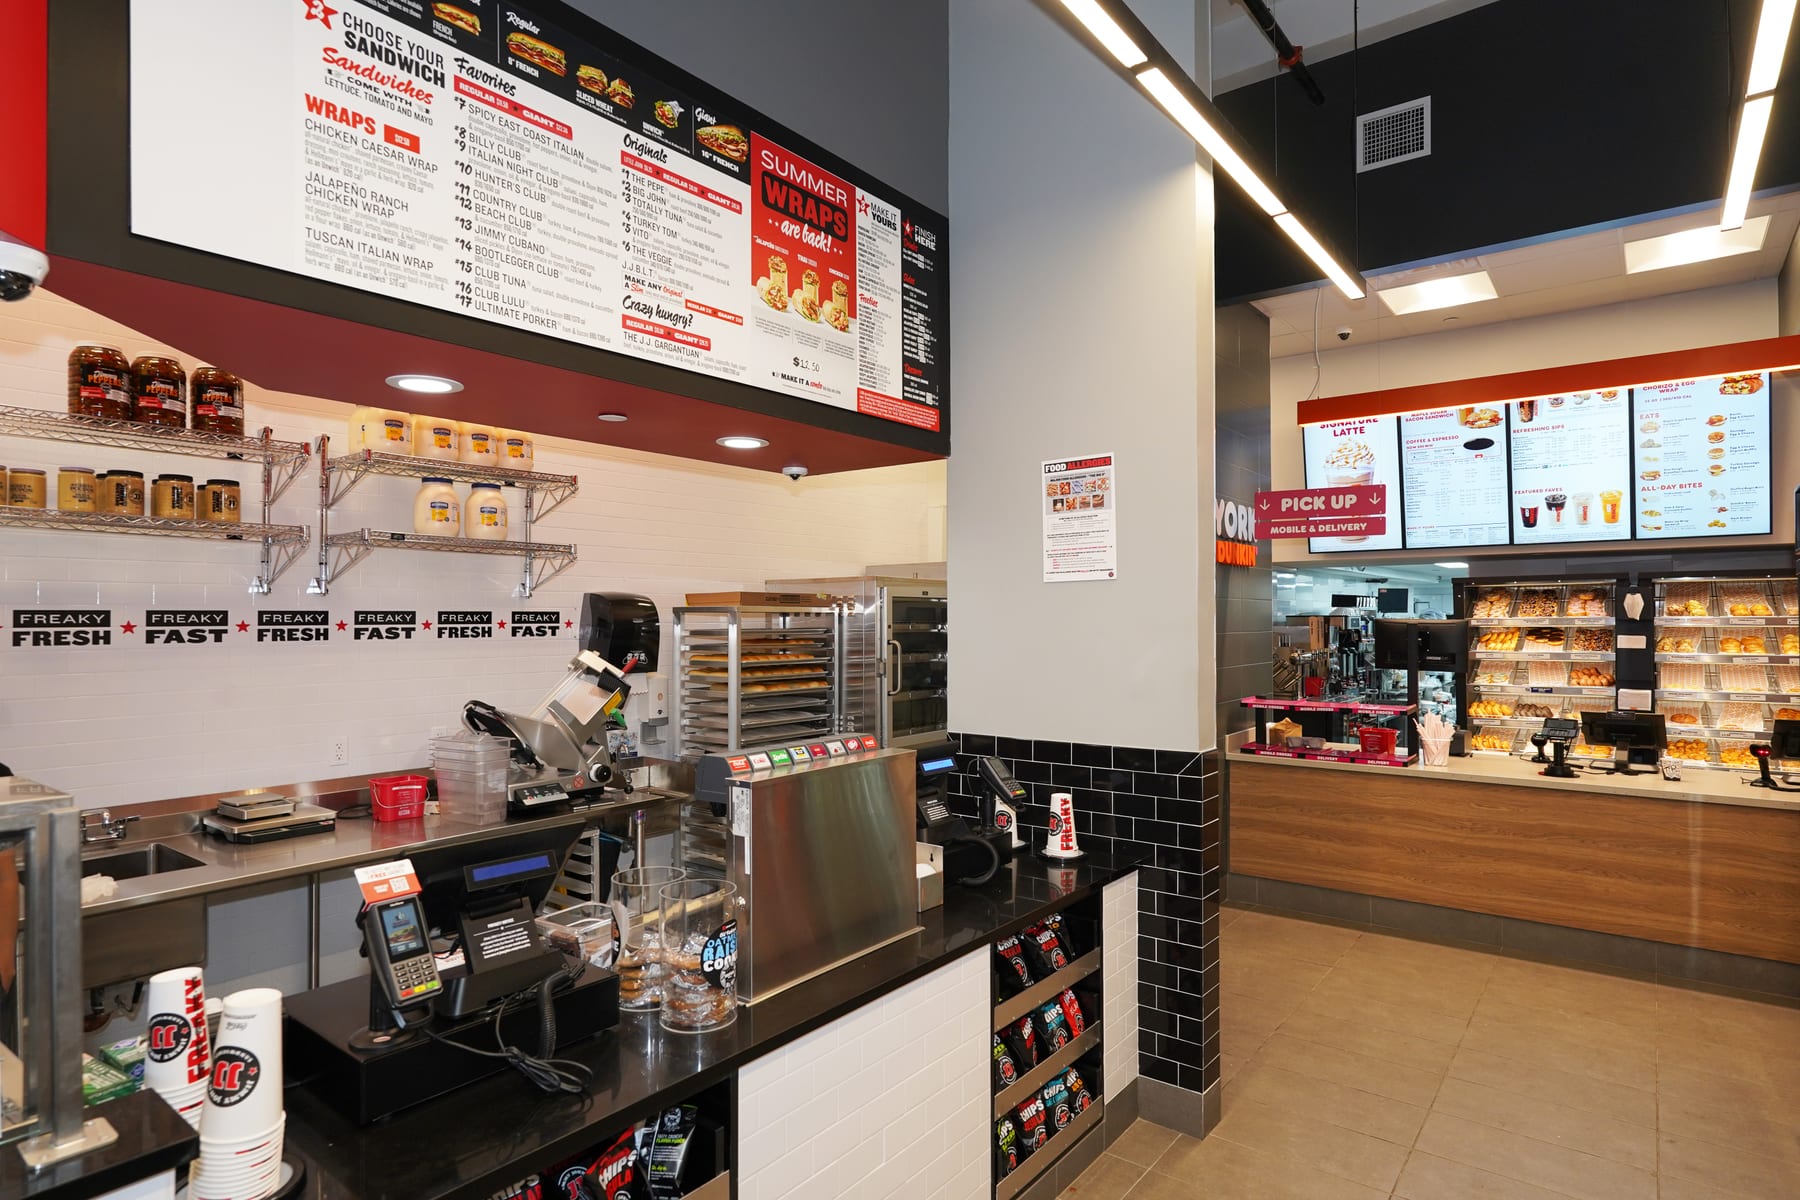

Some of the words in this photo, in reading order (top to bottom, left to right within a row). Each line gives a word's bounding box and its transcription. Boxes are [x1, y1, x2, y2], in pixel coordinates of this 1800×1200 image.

[432, 20, 453, 36] FRENCH
[506, 12, 541, 34] Regular
[343, 12, 402, 51] CHOOSE
[407, 40, 444, 70] YOUR
[344, 30, 445, 88] SANDWICH
[322, 47, 434, 105] Sandwiches
[454, 57, 517, 97] Favorites
[516, 62, 540, 79] FRENCH
[347, 76, 380, 94] COME
[383, 90, 412, 107] WITH
[576, 90, 594, 104] SLICED
[595, 98, 614, 114] WHEAT
[304, 93, 376, 136] WRAPS
[364, 91, 396, 111] TOMATO
[397, 105, 412, 118] AND
[414, 112, 434, 126] MAYO
[460, 82, 496, 104] REGULAR
[522, 110, 554, 128] GIANT
[695, 108, 717, 125] Giant
[468, 104, 494, 124] SPICY
[498, 116, 520, 134] EAST
[523, 126, 552, 144] COAST
[553, 140, 584, 160] ITALIAN
[305, 118, 358, 146] CHICKEN
[362, 139, 405, 163] CAESAR
[408, 155, 438, 174] WRAP
[469, 133, 494, 152] BILLY
[497, 144, 522, 161] CLUB
[624, 134, 668, 164] Originals
[469, 146, 504, 168] ITALIAN
[506, 161, 534, 178] NIGHT
[536, 172, 559, 188] CLUB
[712, 156, 739, 173] FRENCH
[475, 169, 522, 194] HUNTER'S
[524, 187, 547, 204] CLUB
[632, 174, 646, 187] THE
[648, 180, 665, 195] PEPE
[761, 150, 848, 208] SUMMER
[305, 171, 367, 199] JALAPEÑO
[370, 191, 409, 212] RANCH
[305, 183, 358, 209] CHICKEN
[362, 200, 394, 219] WRAP
[632, 186, 646, 198] BIG
[646, 191, 666, 206] JOHN
[473, 189, 518, 212] COUNTRY
[520, 205, 543, 222] CLUB
[475, 202, 506, 222] BEACH
[508, 214, 532, 231] CLUB
[633, 197, 664, 216] TOTALLY
[665, 210, 683, 224] TUNA
[764, 176, 847, 237] WRAPS
[871, 202, 890, 220] MAKE
[891, 212, 897, 222] IT
[633, 216, 661, 232] TURKEY
[662, 226, 678, 239] TOM
[872, 212, 897, 231] YOURS
[474, 224, 506, 242] JIMMY
[508, 234, 546, 255] CUBANO
[632, 227, 648, 240] VITO
[781, 220, 800, 240] are
[802, 224, 832, 253] back!
[914, 224, 936, 242] FINISH
[914, 234, 936, 251] HERE
[305, 227, 354, 250] TUSCAN
[358, 241, 400, 262] ITALIAN
[402, 254, 434, 272] WRAP
[632, 244, 646, 258] THE
[648, 252, 672, 266] VEGGIE
[475, 244, 534, 272] BOOTLEGGER
[536, 264, 560, 279] CLUB
[475, 266, 500, 281] CLUB
[502, 274, 527, 289] TUNA
[624, 274, 646, 287] MAKE
[648, 280, 662, 291] ANY
[475, 286, 500, 302] CLUB
[502, 294, 525, 309] LULU
[474, 300, 520, 320] ULTIMATE
[522, 312, 558, 330] PORKER
[622, 294, 654, 320] Crazy
[655, 304, 694, 330] hungry?
[624, 331, 638, 343] THE
[654, 339, 700, 358] GARGANTUAN
[88, 375, 122, 387] PEPPERS
[781, 373, 798, 384] MAKE
[1642, 383, 1672, 391] CHORIZO
[146, 384, 178, 398] PEPPERS
[202, 394, 232, 404] PEPPERS
[1426, 412, 1454, 420] SANDWICH
[1333, 426, 1366, 438] LATTE
[1512, 425, 1550, 434] REFRESHING
[1046, 464, 1066, 472] FOOD
[1641, 484, 1676, 492] ALL-DAY
[1281, 496, 1326, 512] PICK
[1331, 494, 1358, 510] UP
[1270, 525, 1306, 534] MOBILE
[1308, 524, 1316, 533] &
[1318, 522, 1368, 532] DELIVERY
[20, 614, 106, 624] FREAKY
[152, 614, 224, 623] FREAKY
[263, 614, 325, 623] FREAKY
[13, 630, 111, 646] FRESH
[146, 628, 228, 644] FAST
[257, 628, 329, 642] FRESH
[354, 627, 416, 640] FAST
[438, 626, 492, 638] FRESH
[512, 626, 560, 638] FAST
[1060, 798, 1074, 850] FREAKY
[184, 976, 211, 1084] FREAKY
[1044, 1083, 1065, 1100] CHIPS
